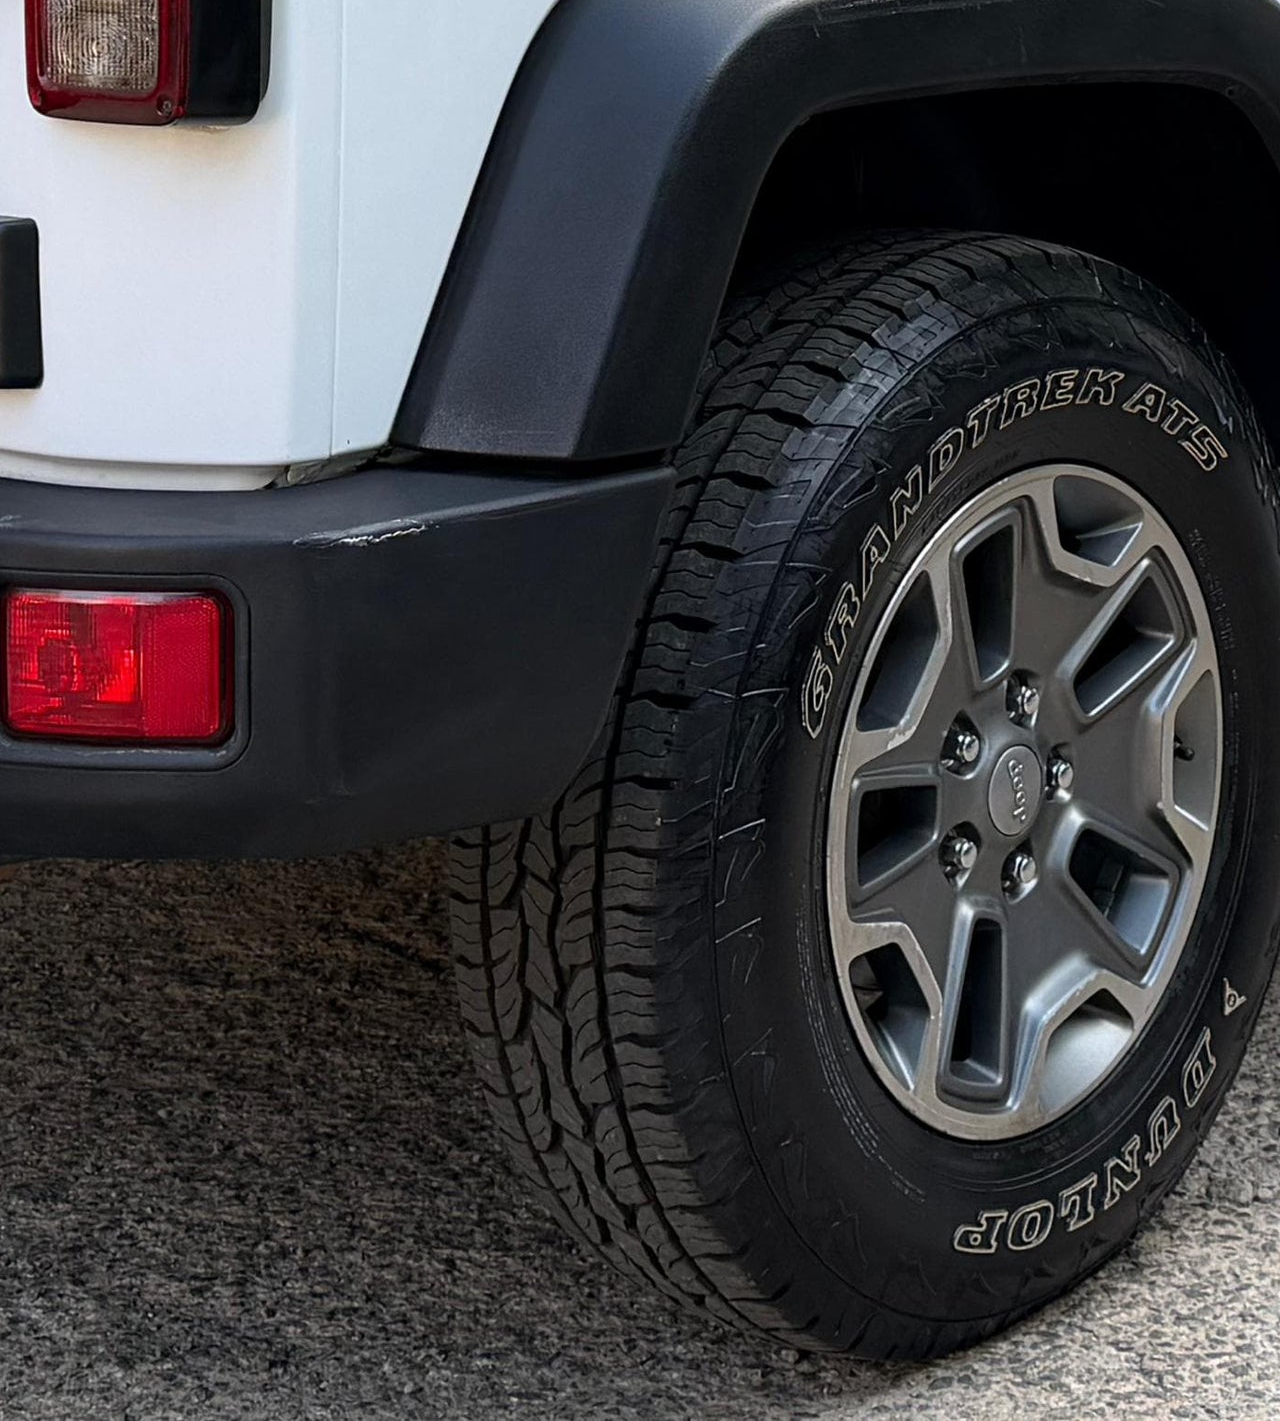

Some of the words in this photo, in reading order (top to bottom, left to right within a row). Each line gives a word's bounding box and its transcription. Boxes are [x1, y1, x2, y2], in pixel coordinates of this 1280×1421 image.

[801, 369, 1125, 739] GRANDTREK
[1008, 759, 1026, 820] Jeep
[954, 1026, 1217, 1254] DUNLOP
